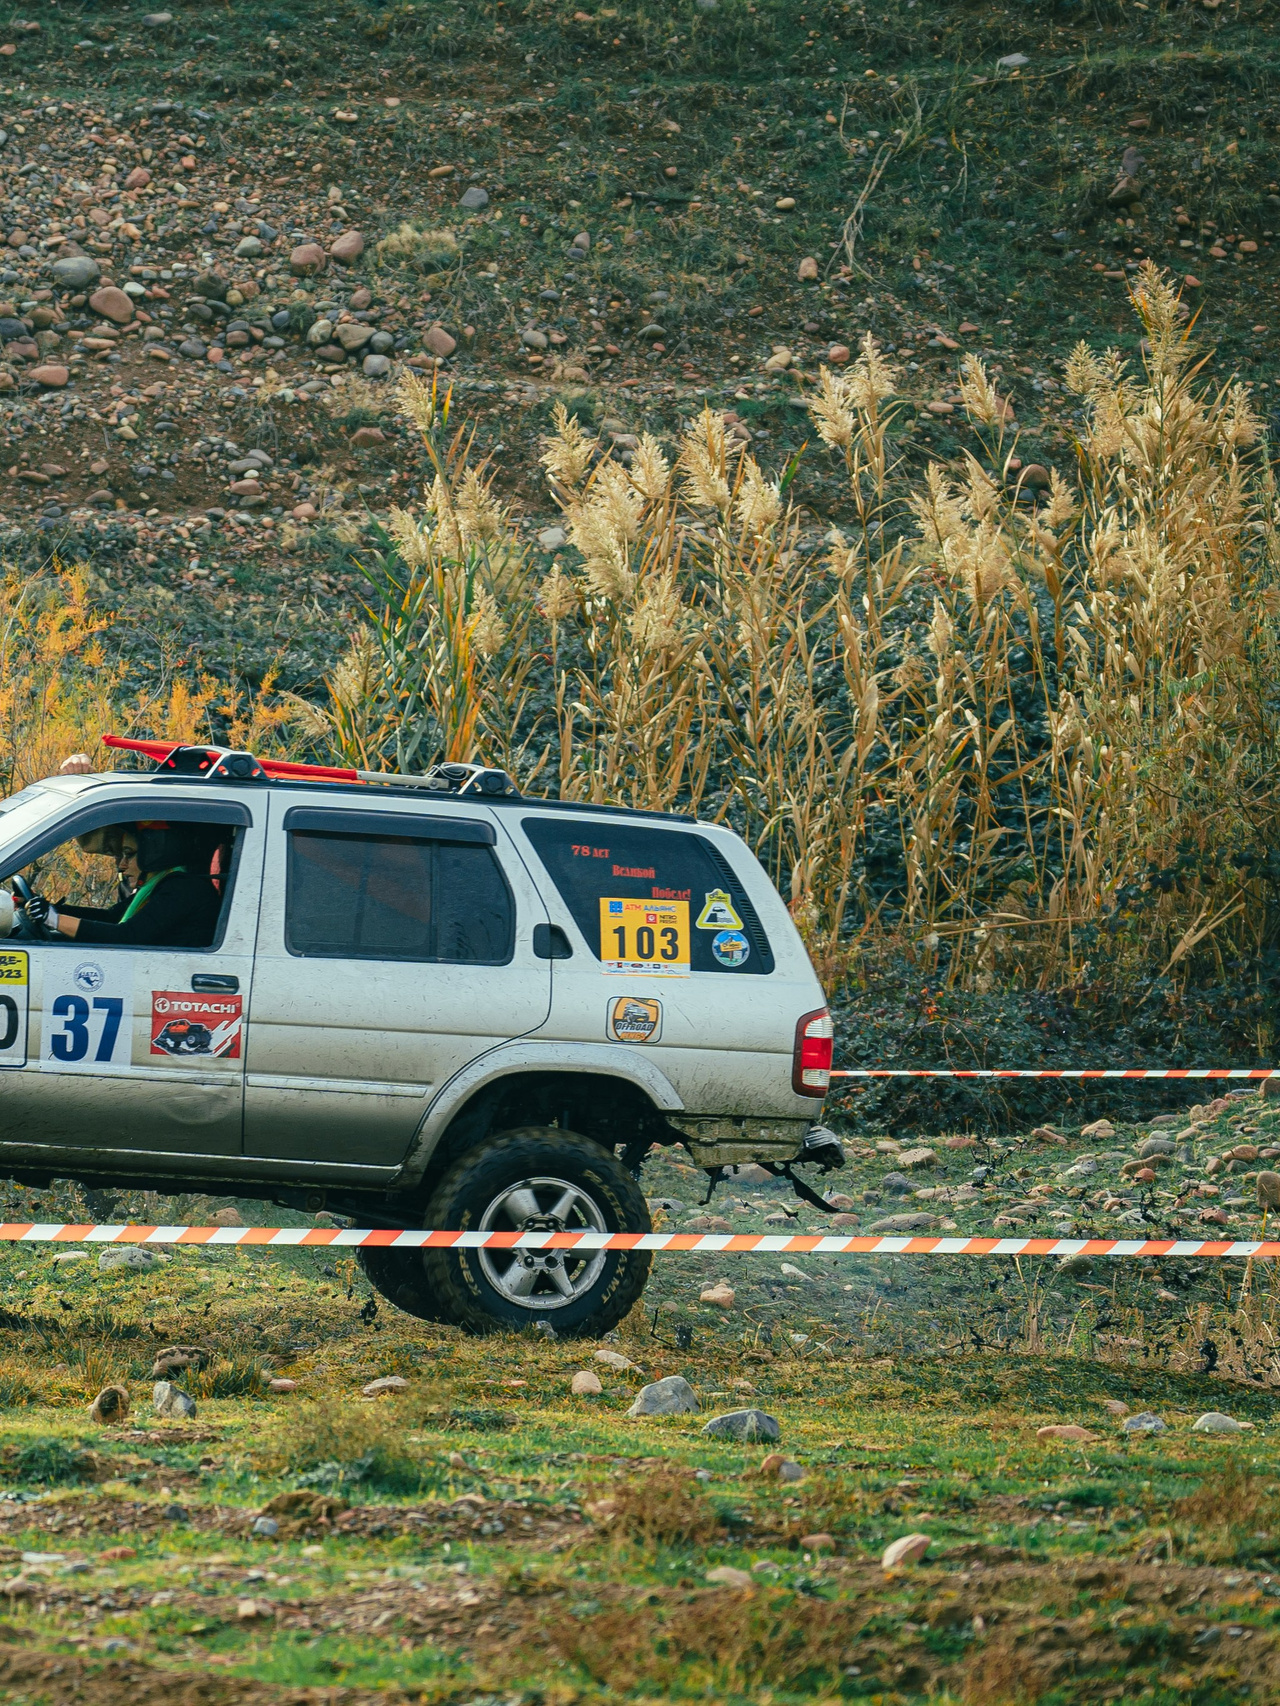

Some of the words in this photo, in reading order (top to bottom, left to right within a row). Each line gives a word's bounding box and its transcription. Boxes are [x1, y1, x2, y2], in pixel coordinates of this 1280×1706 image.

[571, 845, 591, 856] 78
[612, 864, 656, 879] Великой
[612, 925, 679, 960] 103
[171, 1001, 236, 1014] TOTACHI
[51, 995, 124, 1062] 37
[615, 1022, 655, 1031] OFFROAD
